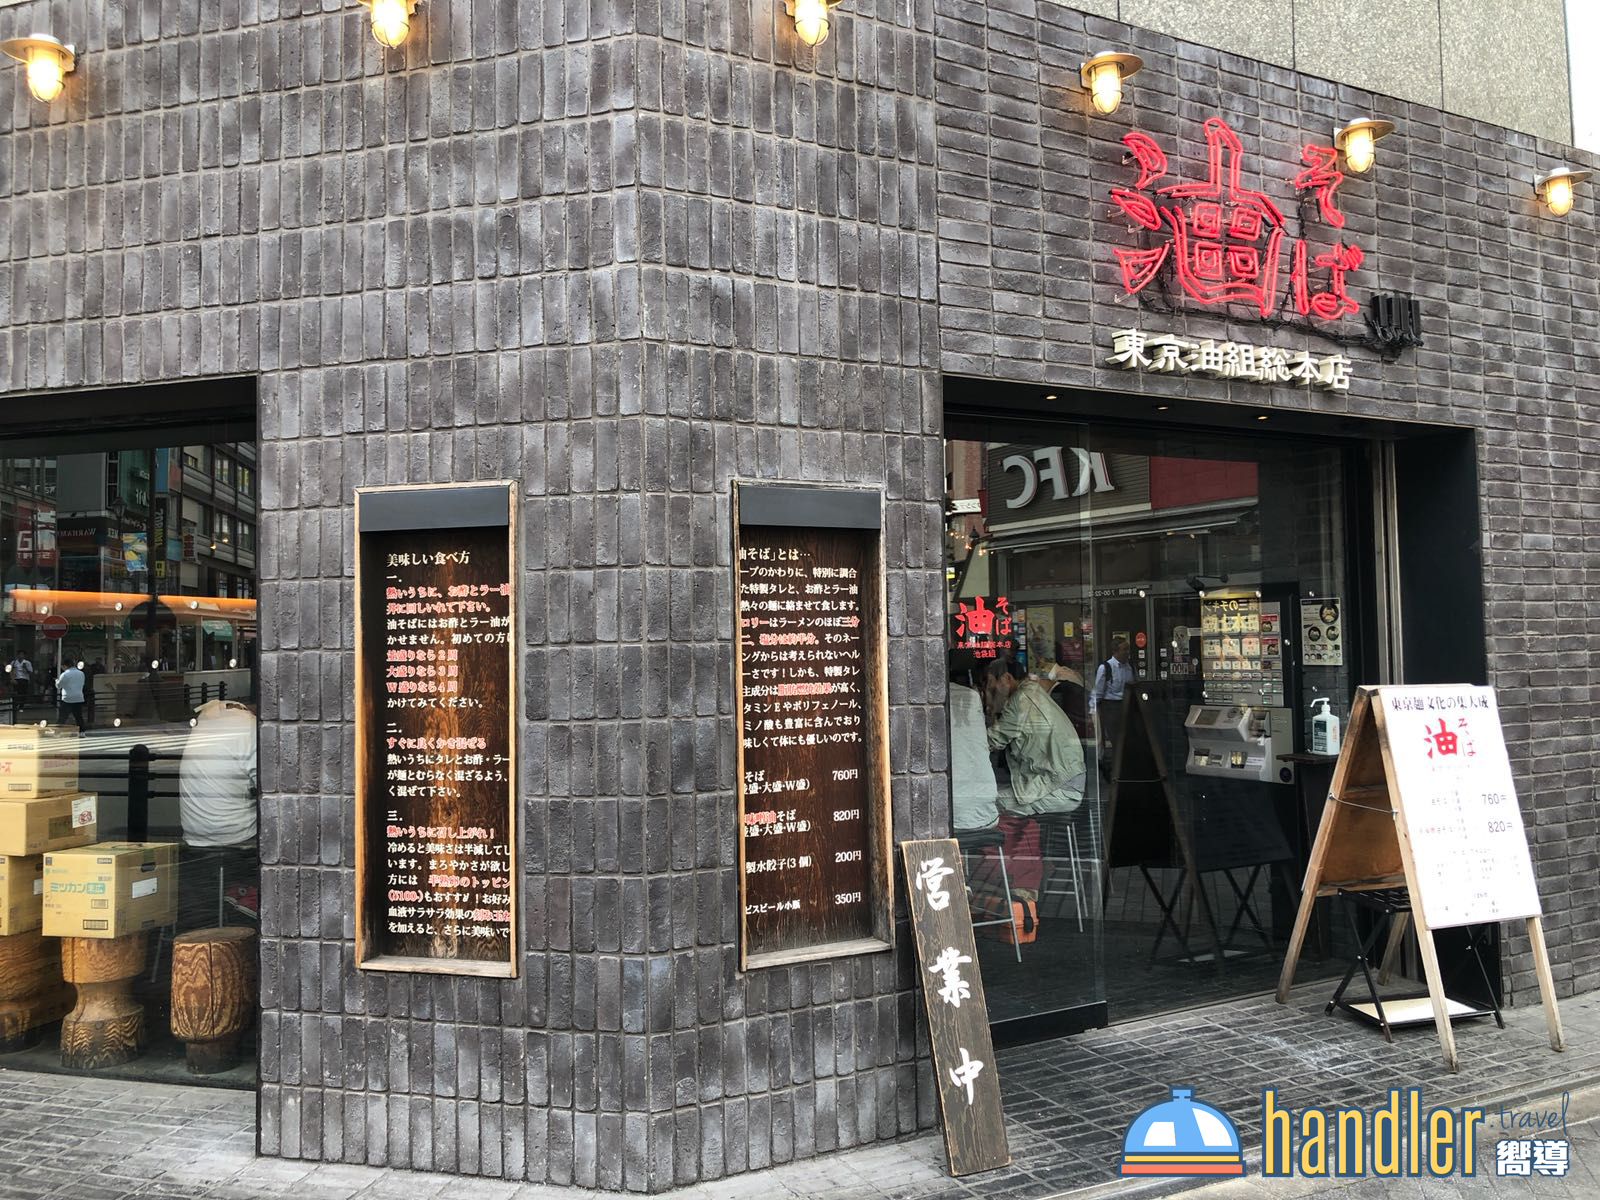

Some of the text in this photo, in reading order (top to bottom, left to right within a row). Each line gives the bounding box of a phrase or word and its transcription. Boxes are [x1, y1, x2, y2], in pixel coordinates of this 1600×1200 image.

[1108, 117, 1364, 320] 油そば
[1106, 328, 1353, 390] 東京油組総本店
[386, 551, 470, 567] 美味しい食べ方
[954, 596, 1012, 638] 油そば
[387, 697, 483, 708] かけてみてください。
[832, 769, 858, 781] 760円
[388, 785, 461, 798] く混ぜて下さい。
[833, 809, 860, 821] 820円
[835, 850, 862, 863] 200円
[835, 892, 861, 904] 350円
[916, 857, 984, 1105] 営業中
